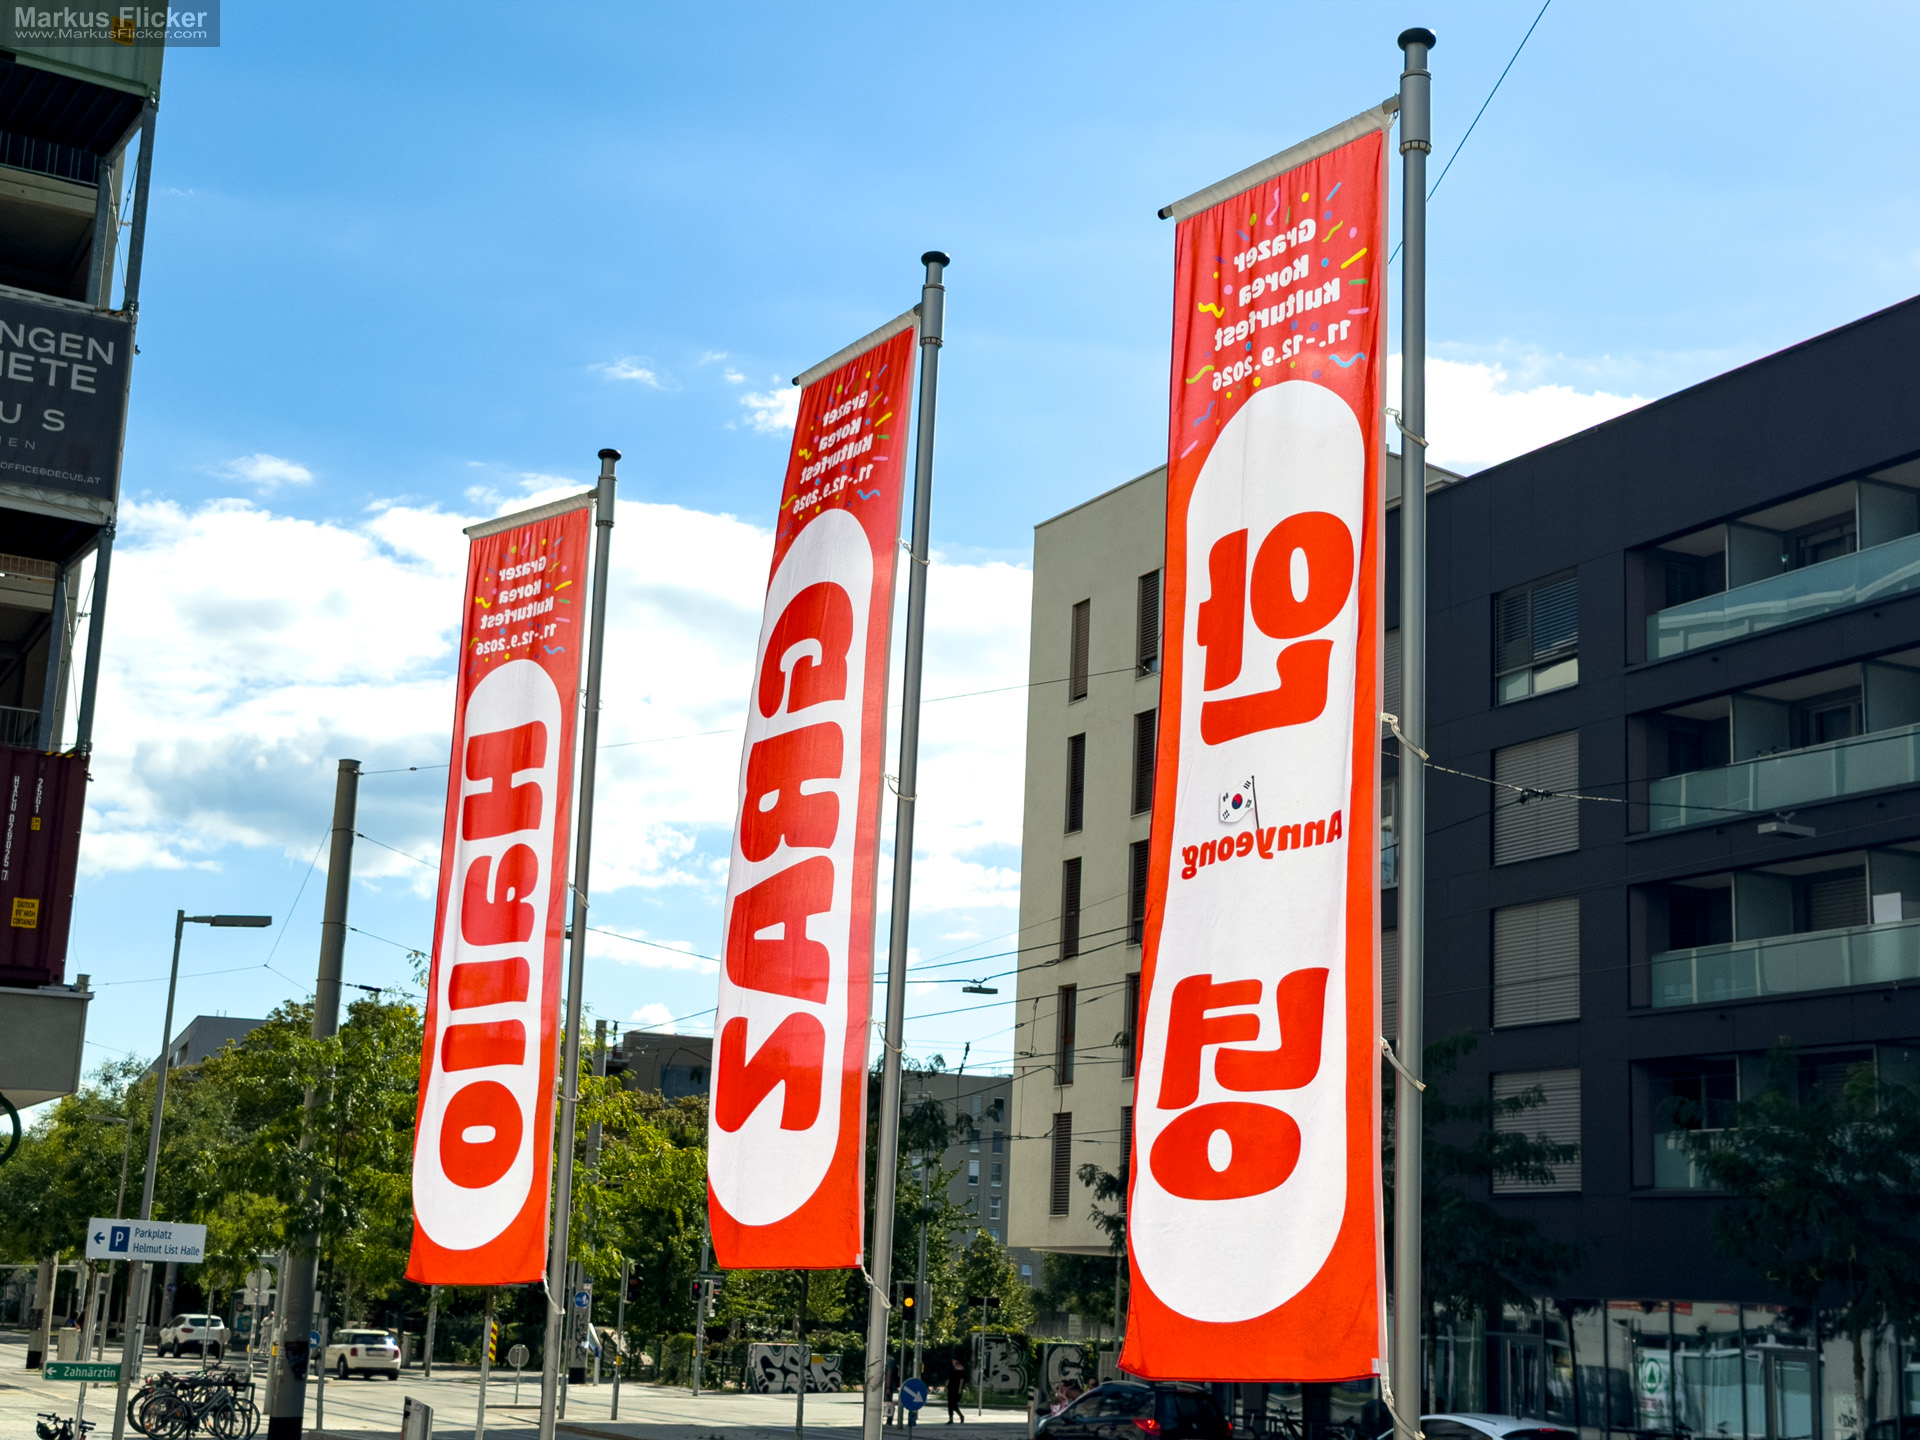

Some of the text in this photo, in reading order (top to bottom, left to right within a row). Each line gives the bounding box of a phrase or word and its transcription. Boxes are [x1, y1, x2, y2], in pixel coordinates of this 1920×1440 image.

[115, 1227, 173, 1247] P Parkplatz
[132, 1242, 200, 1256] Helmut List Halle
[63, 1366, 116, 1378] Zahnärztin
